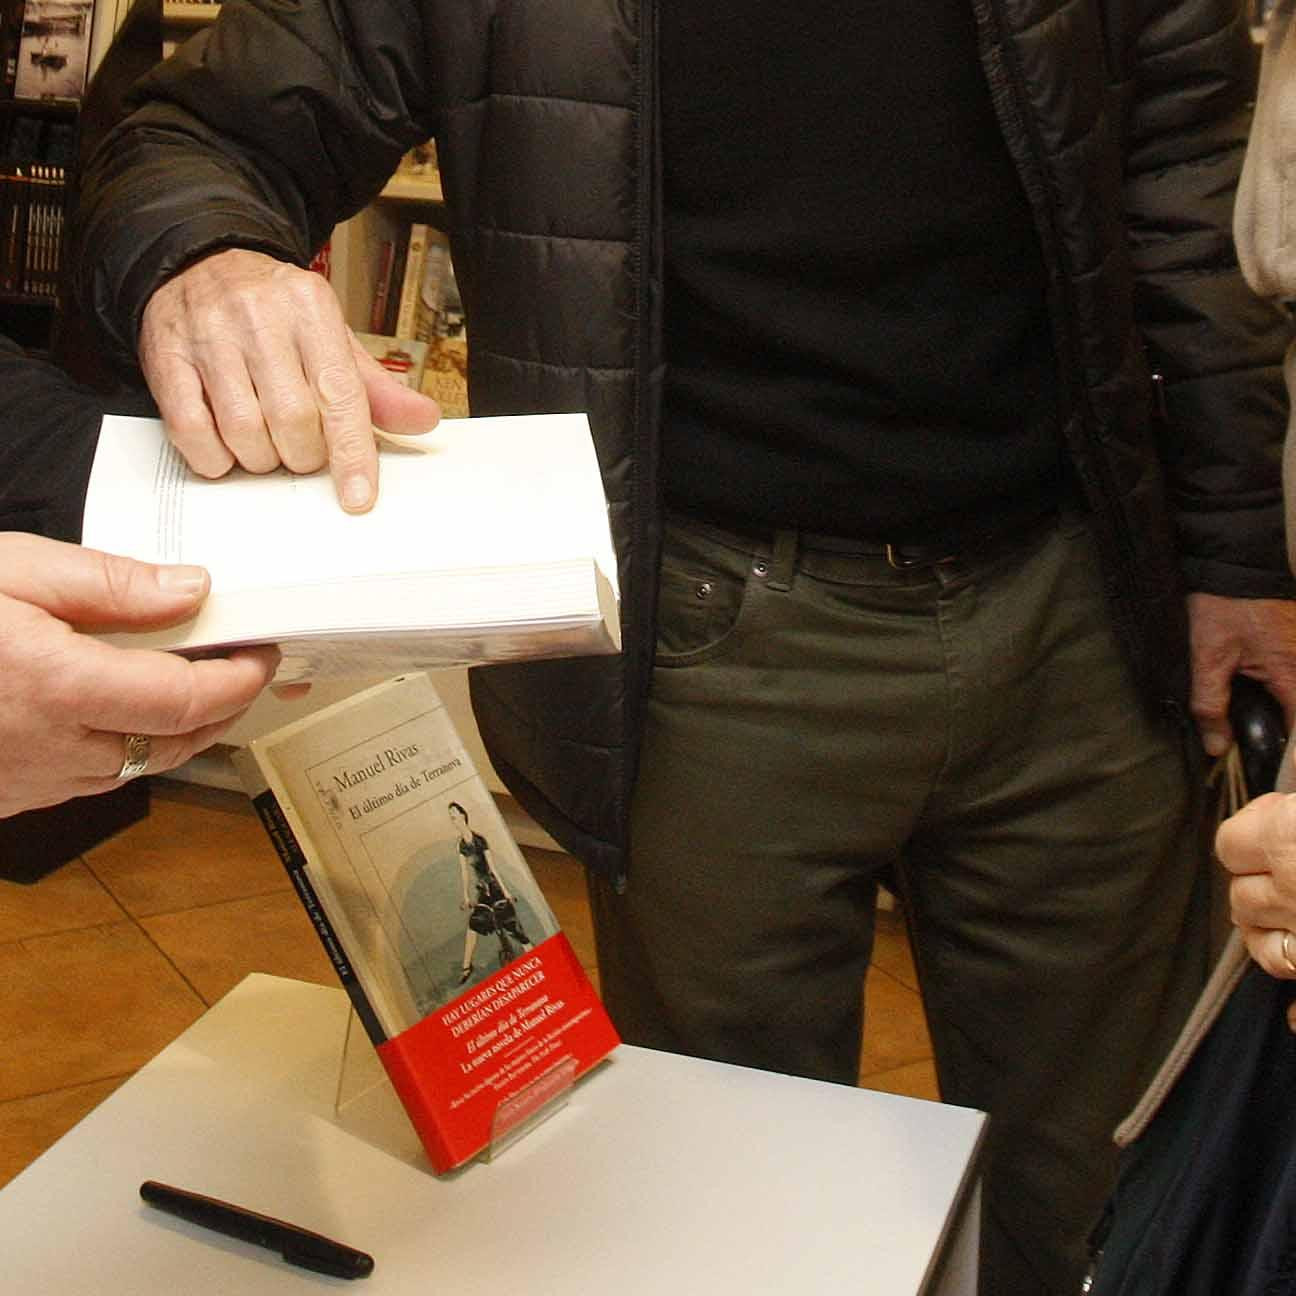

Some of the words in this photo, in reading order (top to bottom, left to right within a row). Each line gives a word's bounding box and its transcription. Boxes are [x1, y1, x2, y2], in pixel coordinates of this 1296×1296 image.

[332, 755, 386, 793] Manuel
[386, 742, 420, 766] Rivas
[348, 806, 362, 821] El
[362, 792, 394, 816] último
[394, 783, 410, 800] día
[410, 778, 422, 793] de
[421, 757, 462, 784] Terranova
[441, 1009, 461, 1026] HAY
[460, 986, 497, 1015] LUGARES
[496, 977, 514, 993] QUE
[512, 956, 543, 978] NUNCA
[492, 970, 545, 1012] DESAPARECER
[460, 1060, 473, 1075] La
